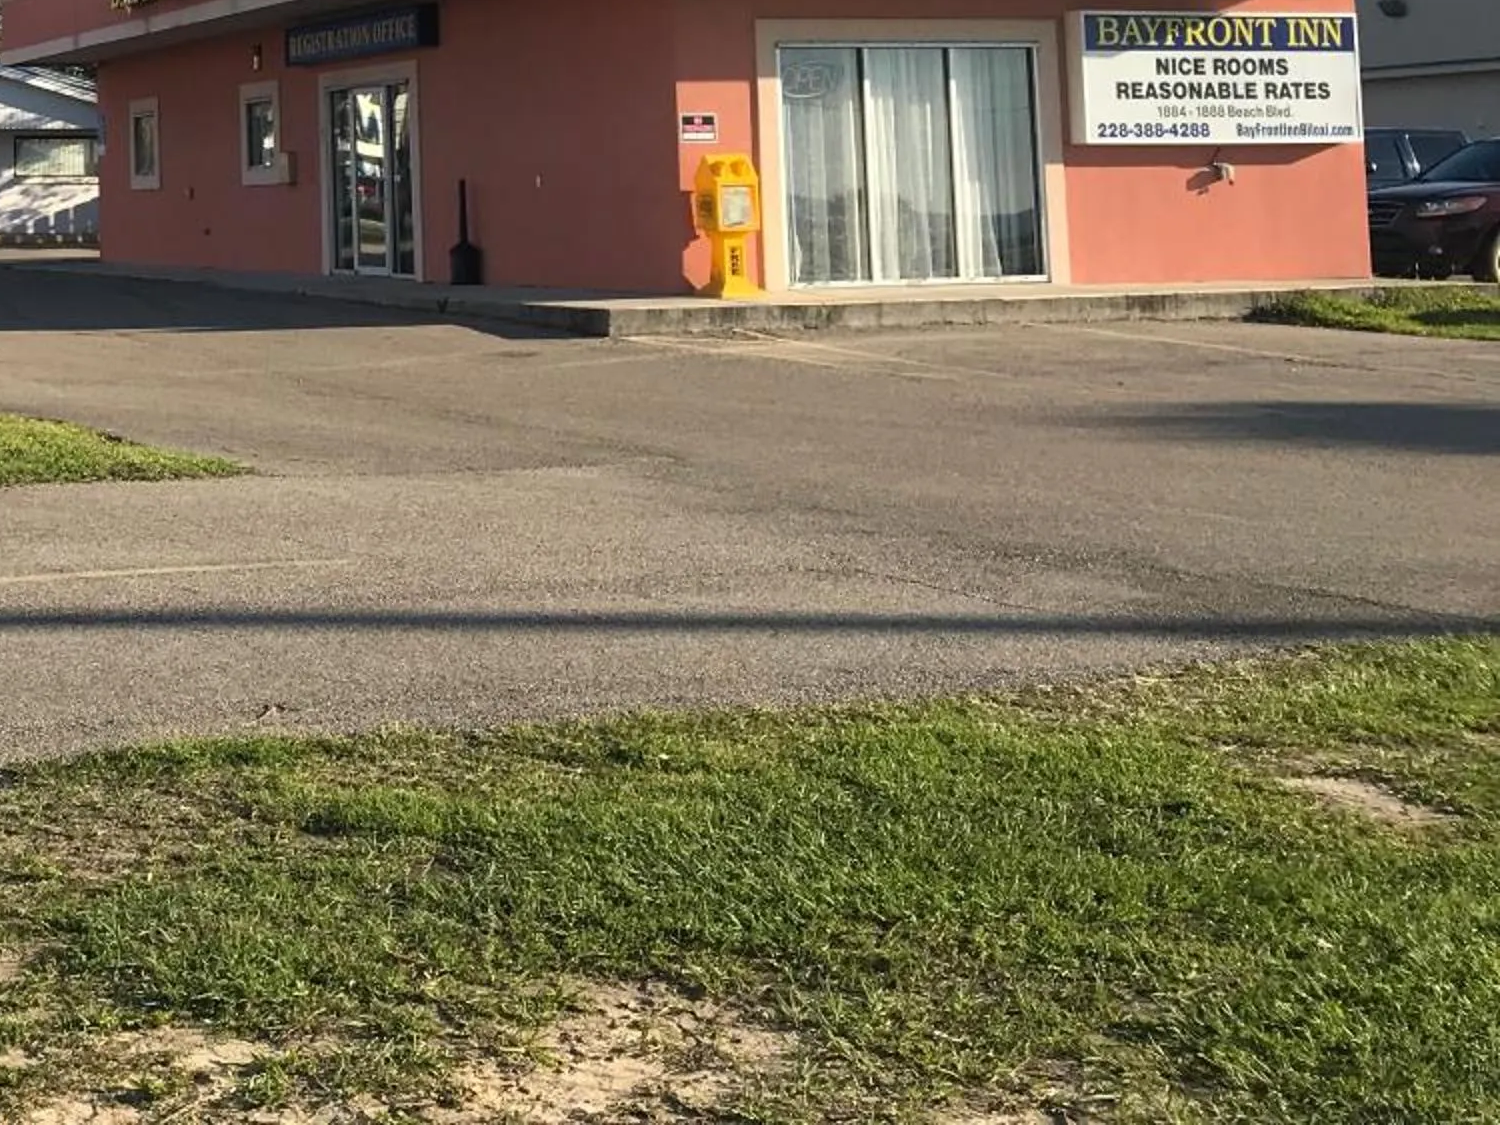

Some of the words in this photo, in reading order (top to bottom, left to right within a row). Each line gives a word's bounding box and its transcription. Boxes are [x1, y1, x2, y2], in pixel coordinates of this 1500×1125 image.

[289, 26, 370, 56] REGISTRATION
[373, 14, 415, 43] OFFICE
[1096, 16, 1276, 46] BAYFRONT
[1287, 18, 1342, 47] INN
[1155, 58, 1206, 76] NICE
[1213, 58, 1289, 76] ROOMS
[1116, 82, 1258, 100] REASONABLE
[1264, 82, 1331, 100] RATES
[1227, 105, 1264, 118] Beach
[1097, 123, 1211, 137] 228-388-4288
